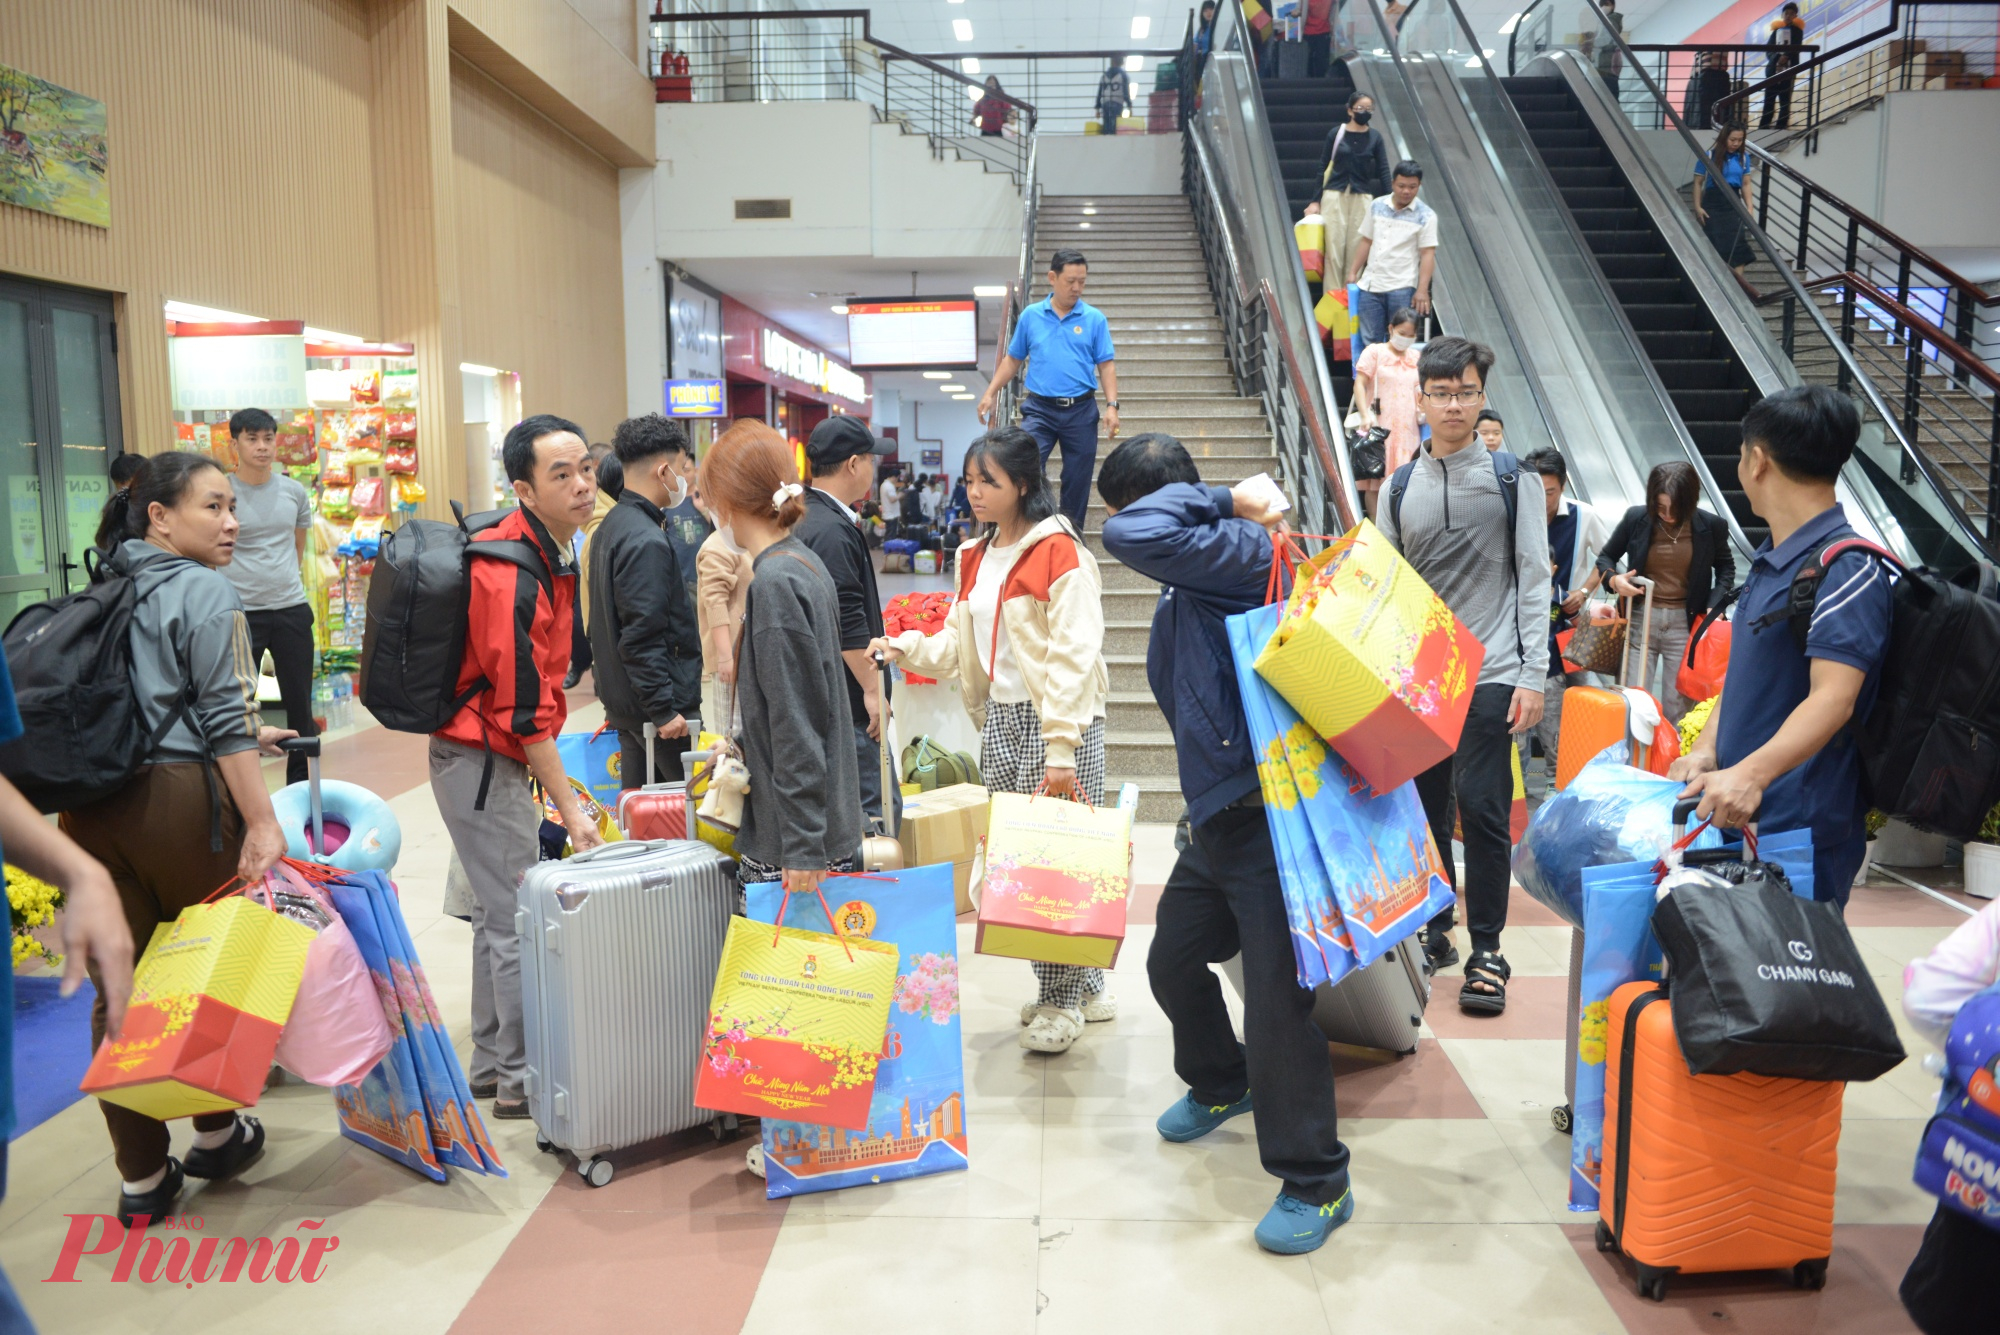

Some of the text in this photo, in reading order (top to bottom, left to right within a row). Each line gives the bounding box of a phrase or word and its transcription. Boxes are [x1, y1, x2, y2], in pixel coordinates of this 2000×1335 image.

[1757, 964, 1818, 983] CHAMY
[856, 992, 874, 1000] NAM
[796, 1094, 811, 1102] YEAR
